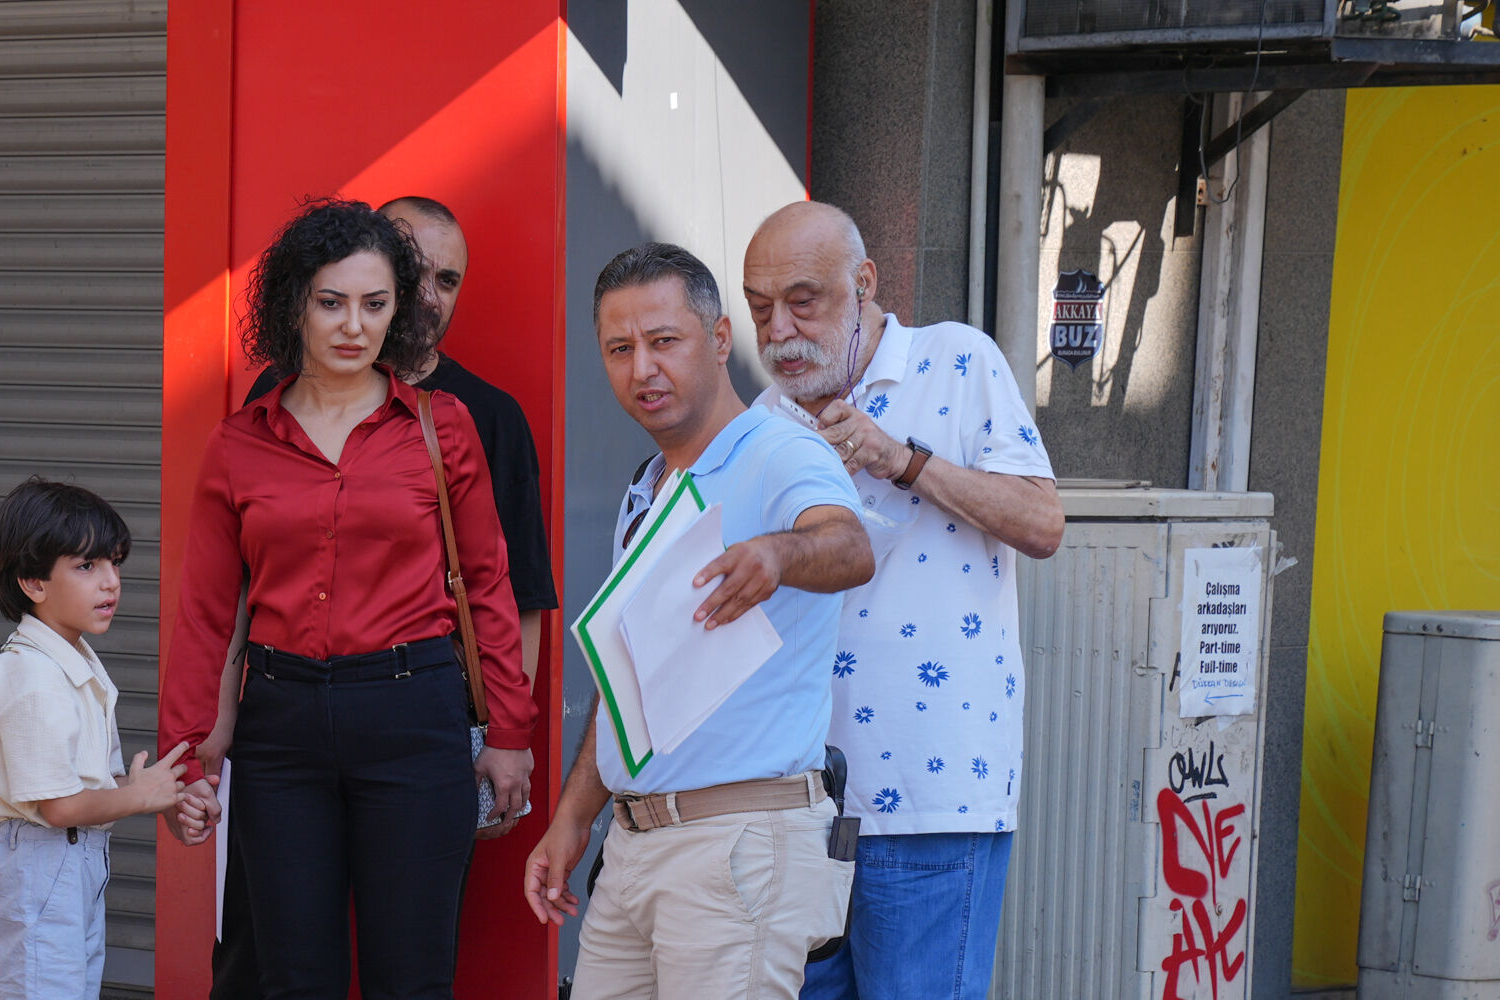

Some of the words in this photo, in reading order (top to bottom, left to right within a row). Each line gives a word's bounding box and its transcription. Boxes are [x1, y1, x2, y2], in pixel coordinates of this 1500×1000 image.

[1055, 303, 1101, 319] AKKAYA
[1054, 325, 1098, 348] BUZ
[1205, 581, 1241, 599] Çalışma
[1196, 601, 1247, 618] arkadaşları
[1199, 641, 1241, 655] Part-time
[1199, 660, 1238, 674] Full-time
